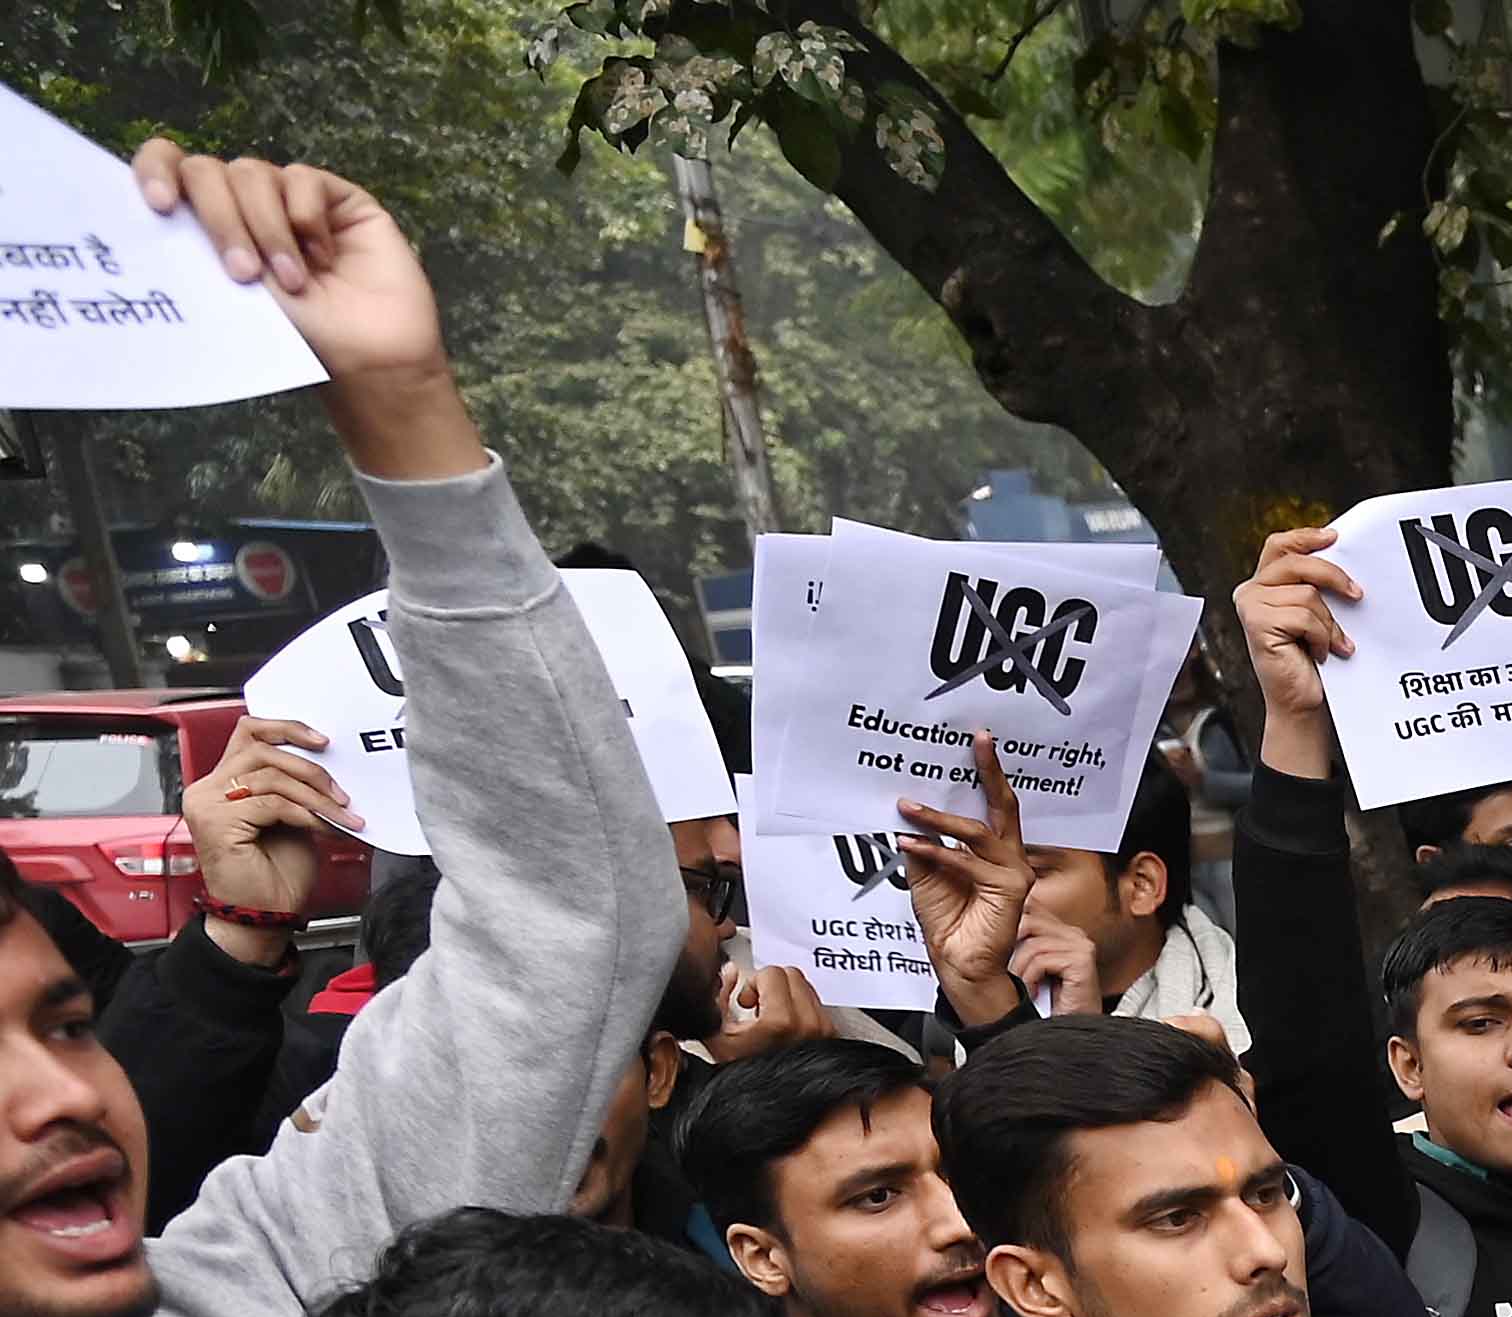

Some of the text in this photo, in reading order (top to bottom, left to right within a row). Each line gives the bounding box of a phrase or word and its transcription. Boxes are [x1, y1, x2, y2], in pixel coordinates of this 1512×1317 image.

[68, 290, 184, 324] चलेगी
[929, 571, 1099, 699] UGC
[847, 704, 973, 748] Education
[1003, 739, 1045, 760] our
[1048, 740, 1106, 769] right,
[1395, 711, 1446, 741] UGC
[1449, 702, 1483, 731] की
[813, 947, 932, 977] विरोधी नियम
